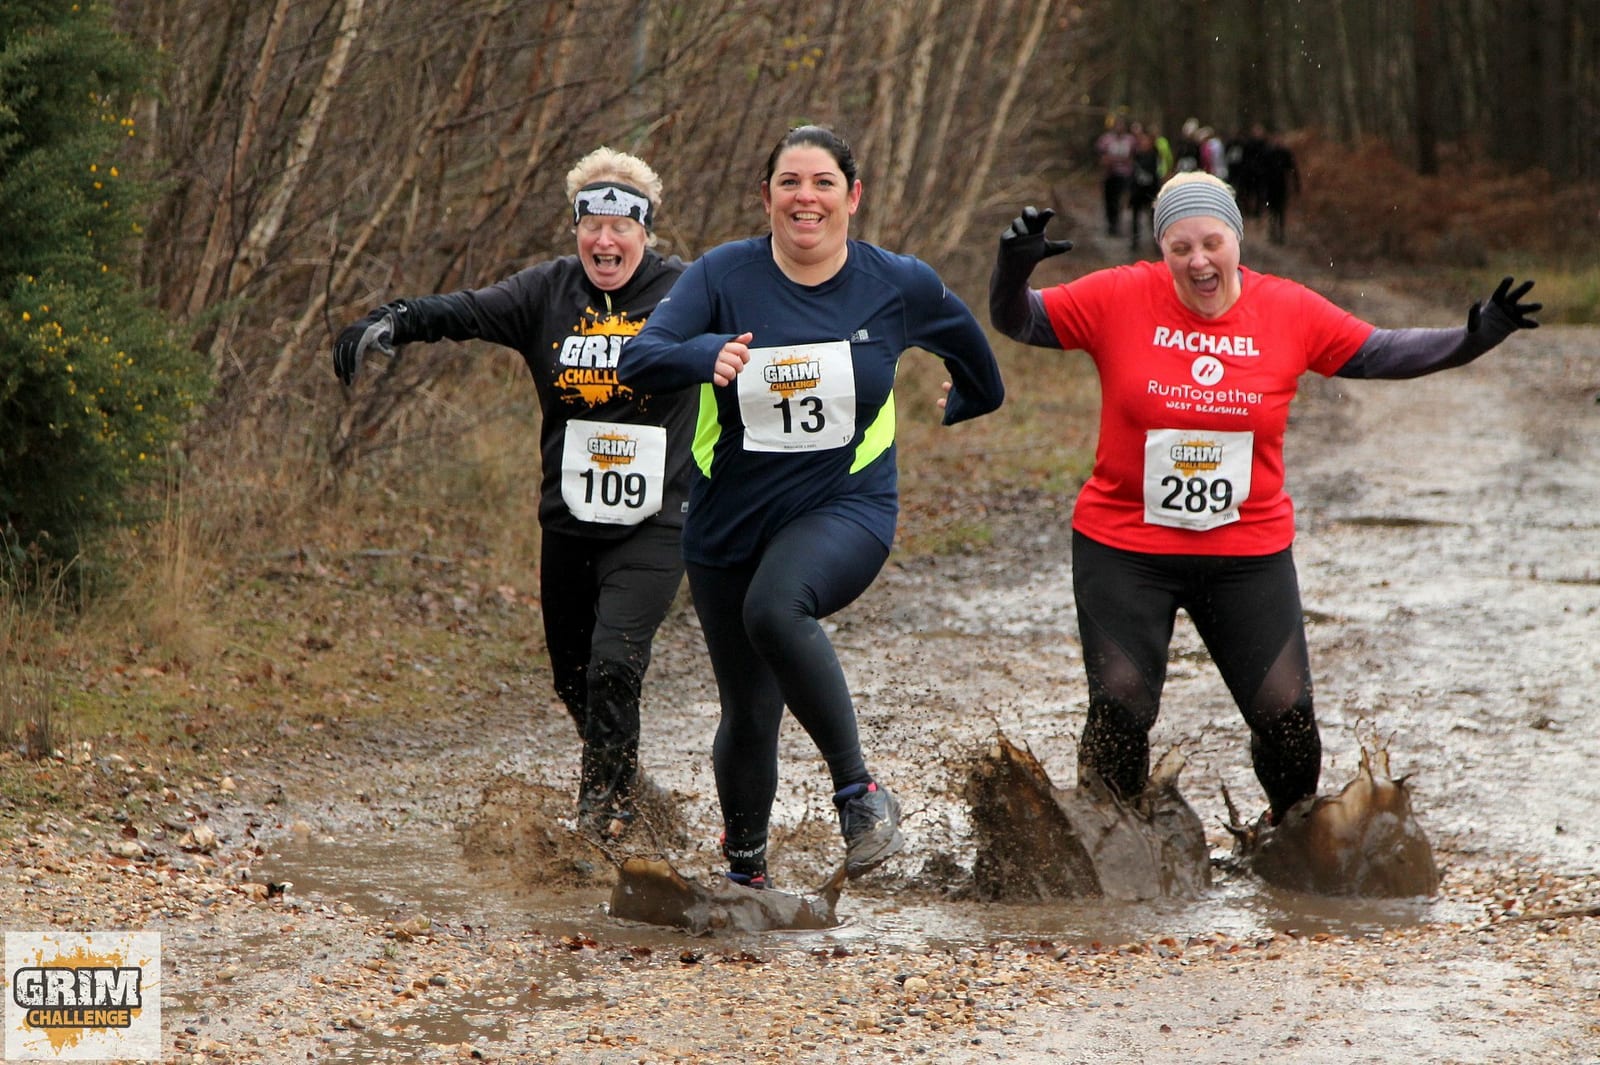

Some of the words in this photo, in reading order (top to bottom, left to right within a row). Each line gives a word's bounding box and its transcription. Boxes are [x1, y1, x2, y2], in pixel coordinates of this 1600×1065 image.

[1153, 326, 1260, 357] RACHAEL
[764, 361, 820, 383] GRIM
[771, 379, 817, 391] CHALLENGE
[1147, 380, 1263, 404] RunTogether
[773, 396, 825, 433] 13
[1166, 401, 1192, 411] WEST
[1195, 403, 1249, 416] BERKSHIRE
[588, 437, 637, 457] GRIM
[1170, 445, 1222, 463] GRIM
[580, 468, 647, 509] 109
[1161, 476, 1232, 513] 289
